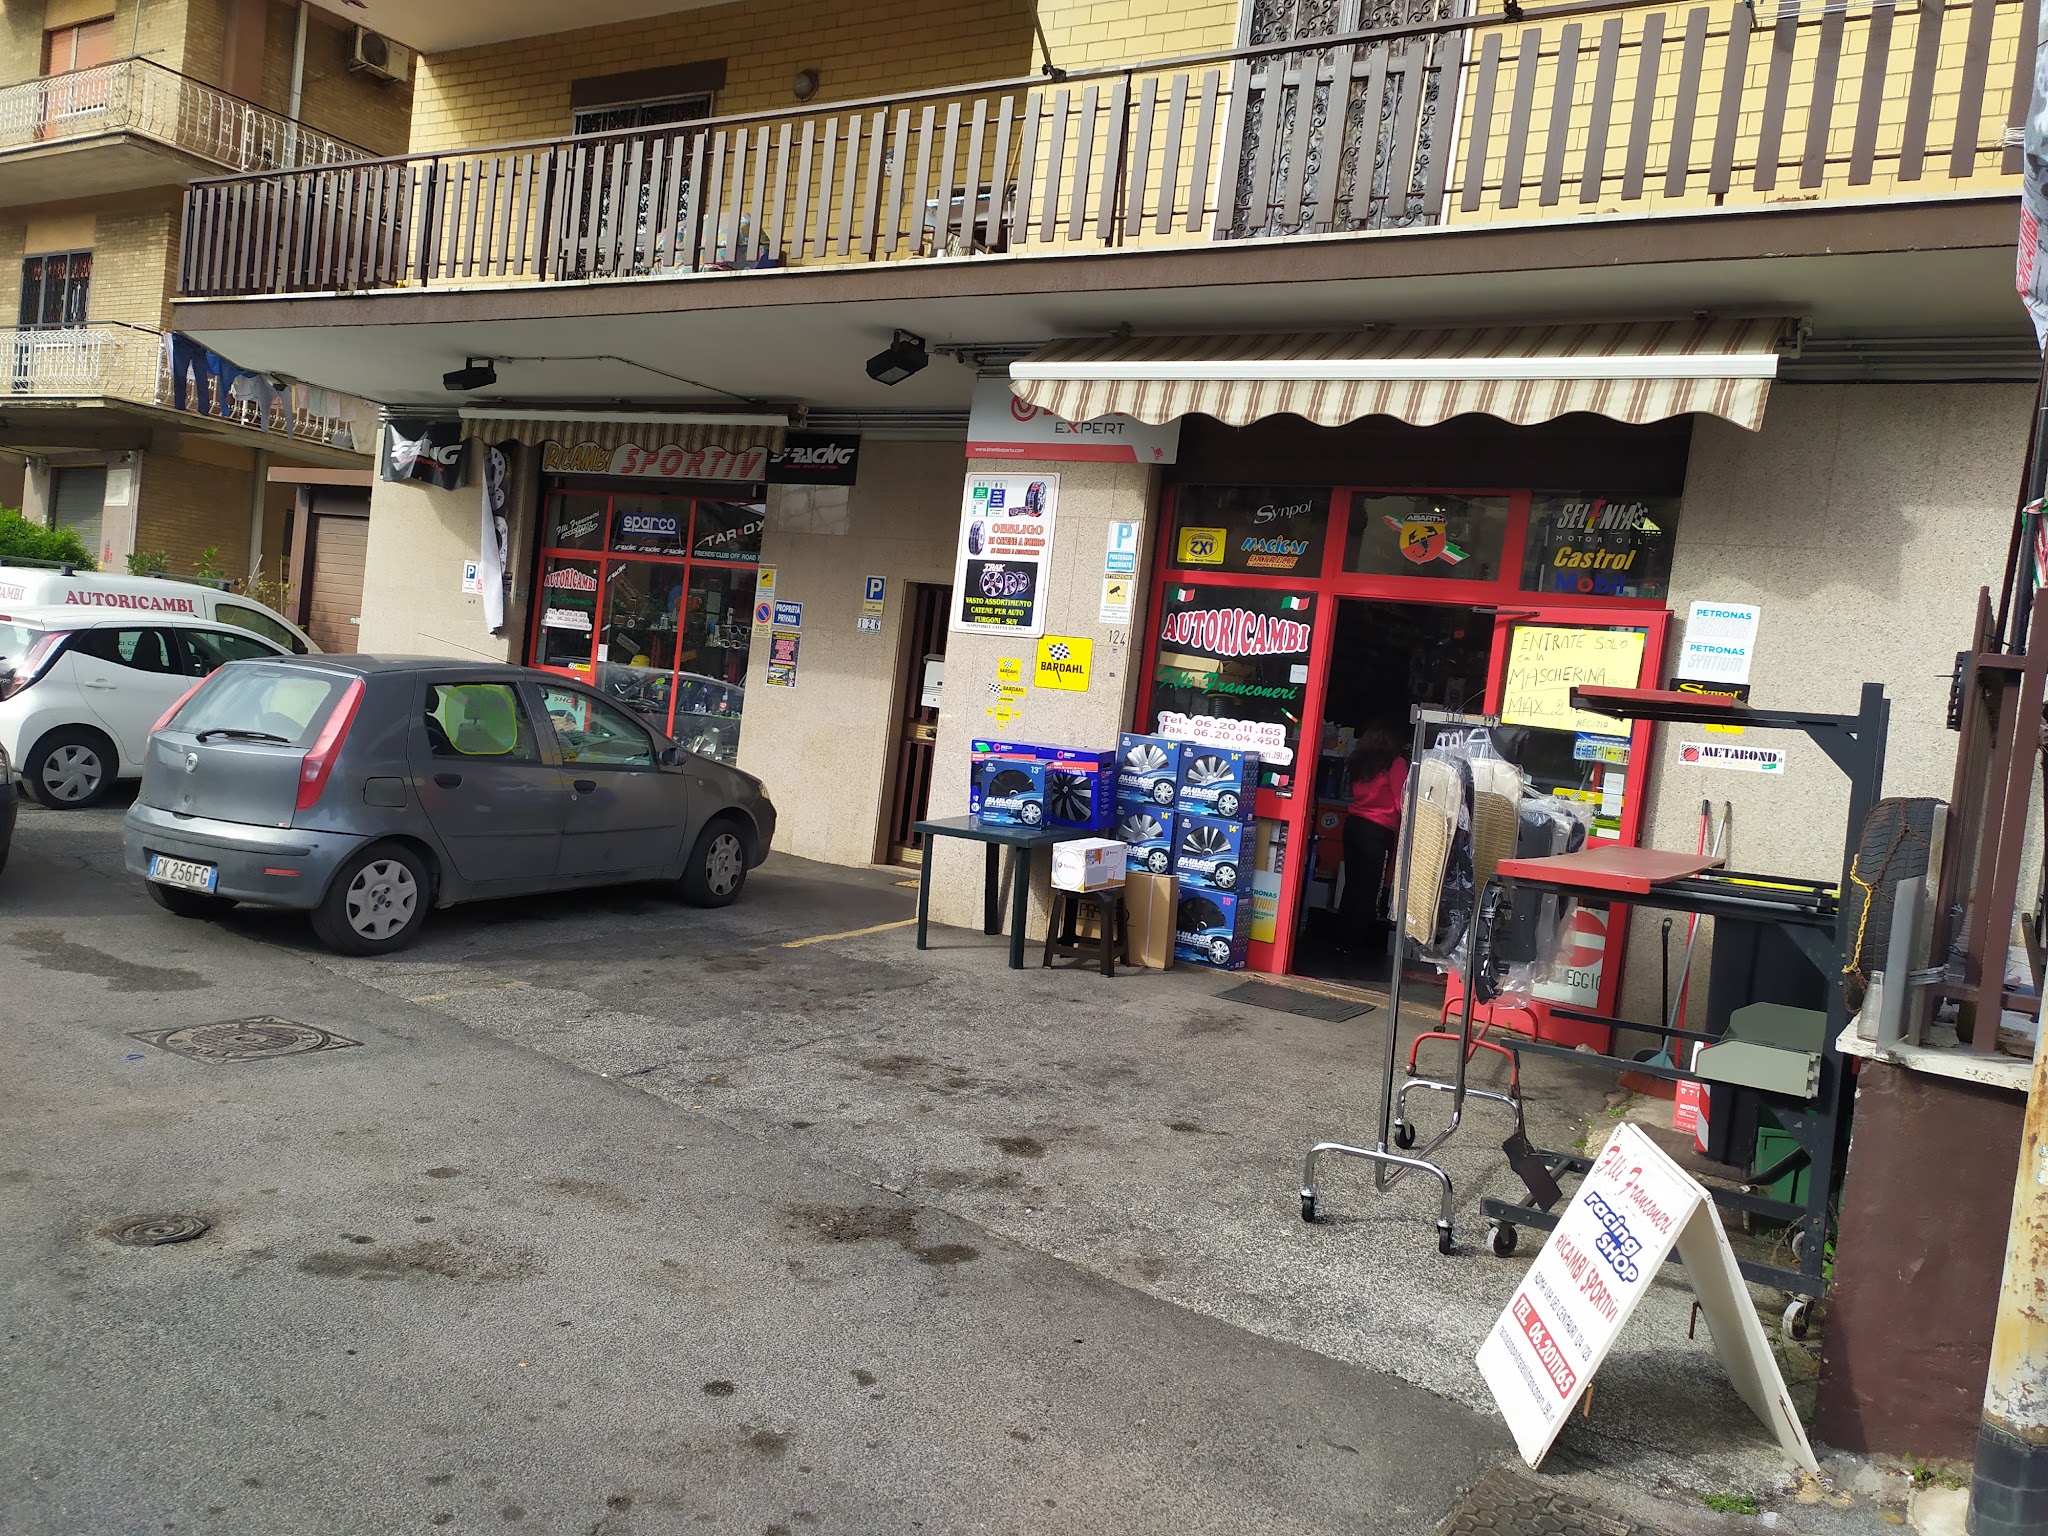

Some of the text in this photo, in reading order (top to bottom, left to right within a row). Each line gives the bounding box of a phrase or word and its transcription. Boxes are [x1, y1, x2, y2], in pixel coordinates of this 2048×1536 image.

[1055, 422, 1125, 435] EXPERT
[544, 445, 612, 473] RICAMBI
[1254, 500, 1312, 524] Synpol
[1556, 500, 1640, 533] SELENIA
[623, 515, 676, 533] sparco
[992, 523, 1044, 535] OBBLIGO
[1190, 541, 1213, 555] ZX1
[1556, 535, 1643, 545] MOTOR OIL
[1554, 547, 1637, 571] Castrol
[544, 568, 597, 591] AUTORICAMBI
[869, 579, 882, 598] P
[1554, 572, 1626, 595] Mobil
[65, 590, 195, 613] AUTORICAMBI
[965, 597, 1032, 608] VASTO ASSORTIMENTO
[974, 616, 1001, 624] FURGONI
[1696, 609, 1752, 620] PETRONAS
[1109, 630, 1126, 645] 124
[1162, 608, 1311, 656] AUTORICAMBI
[1521, 632, 1628, 651] ENTRATE SOLO
[1690, 644, 1745, 656] PETRONAS
[1041, 662, 1085, 674] BARDAHL
[1687, 654, 1744, 673] SYNTIUM
[1159, 667, 1299, 700] F.lli Franconeri
[1509, 667, 1606, 690] MASCHERINA
[1507, 696, 1544, 716] MAX
[1162, 715, 1282, 737] Tel. 06.20.11.165
[1162, 724, 1280, 746] Fax. 06.20.04.450
[156, 859, 209, 885] CK 256FG
[1680, 1104, 1698, 1112] MOTU
[1618, 1167, 1678, 1234] Franconeri
[1584, 1191, 1642, 1258] racing
[1596, 1232, 1639, 1282] SHOP
[1555, 1234, 1618, 1323] RICAMBI SPORTIVI
[1533, 1271, 1548, 1290] ROMA
[1555, 1305, 1579, 1340] CENTAURI
[1515, 1301, 1575, 1393] TEL. 06.2011165
